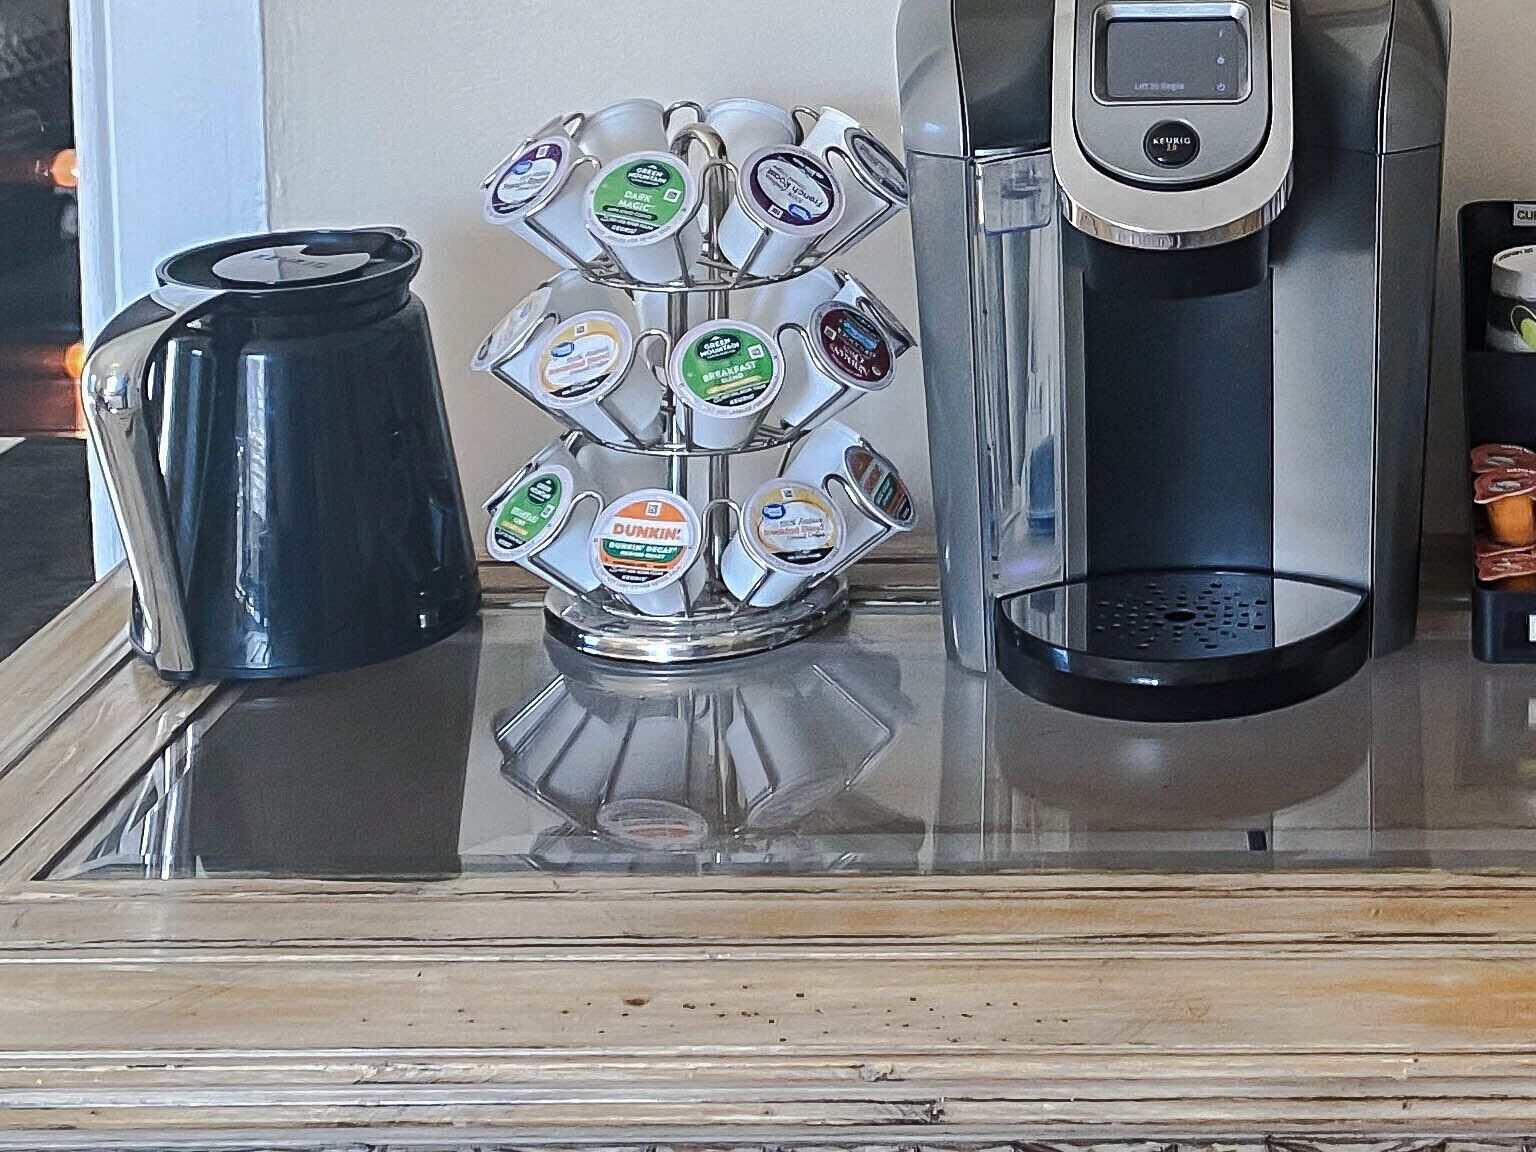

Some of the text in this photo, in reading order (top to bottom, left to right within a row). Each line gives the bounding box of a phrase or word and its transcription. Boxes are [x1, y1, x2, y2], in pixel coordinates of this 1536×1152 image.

[1152, 137, 1191, 145] KEURIG
[635, 166, 664, 180] GREEN
[623, 190, 653, 203] DARK
[617, 199, 650, 213] MAGIC
[699, 341, 740, 358] MOUNTAIN
[703, 337, 731, 350] GREEN
[702, 360, 757, 383] BREAKFAST
[612, 522, 681, 540] DUNKIN'
